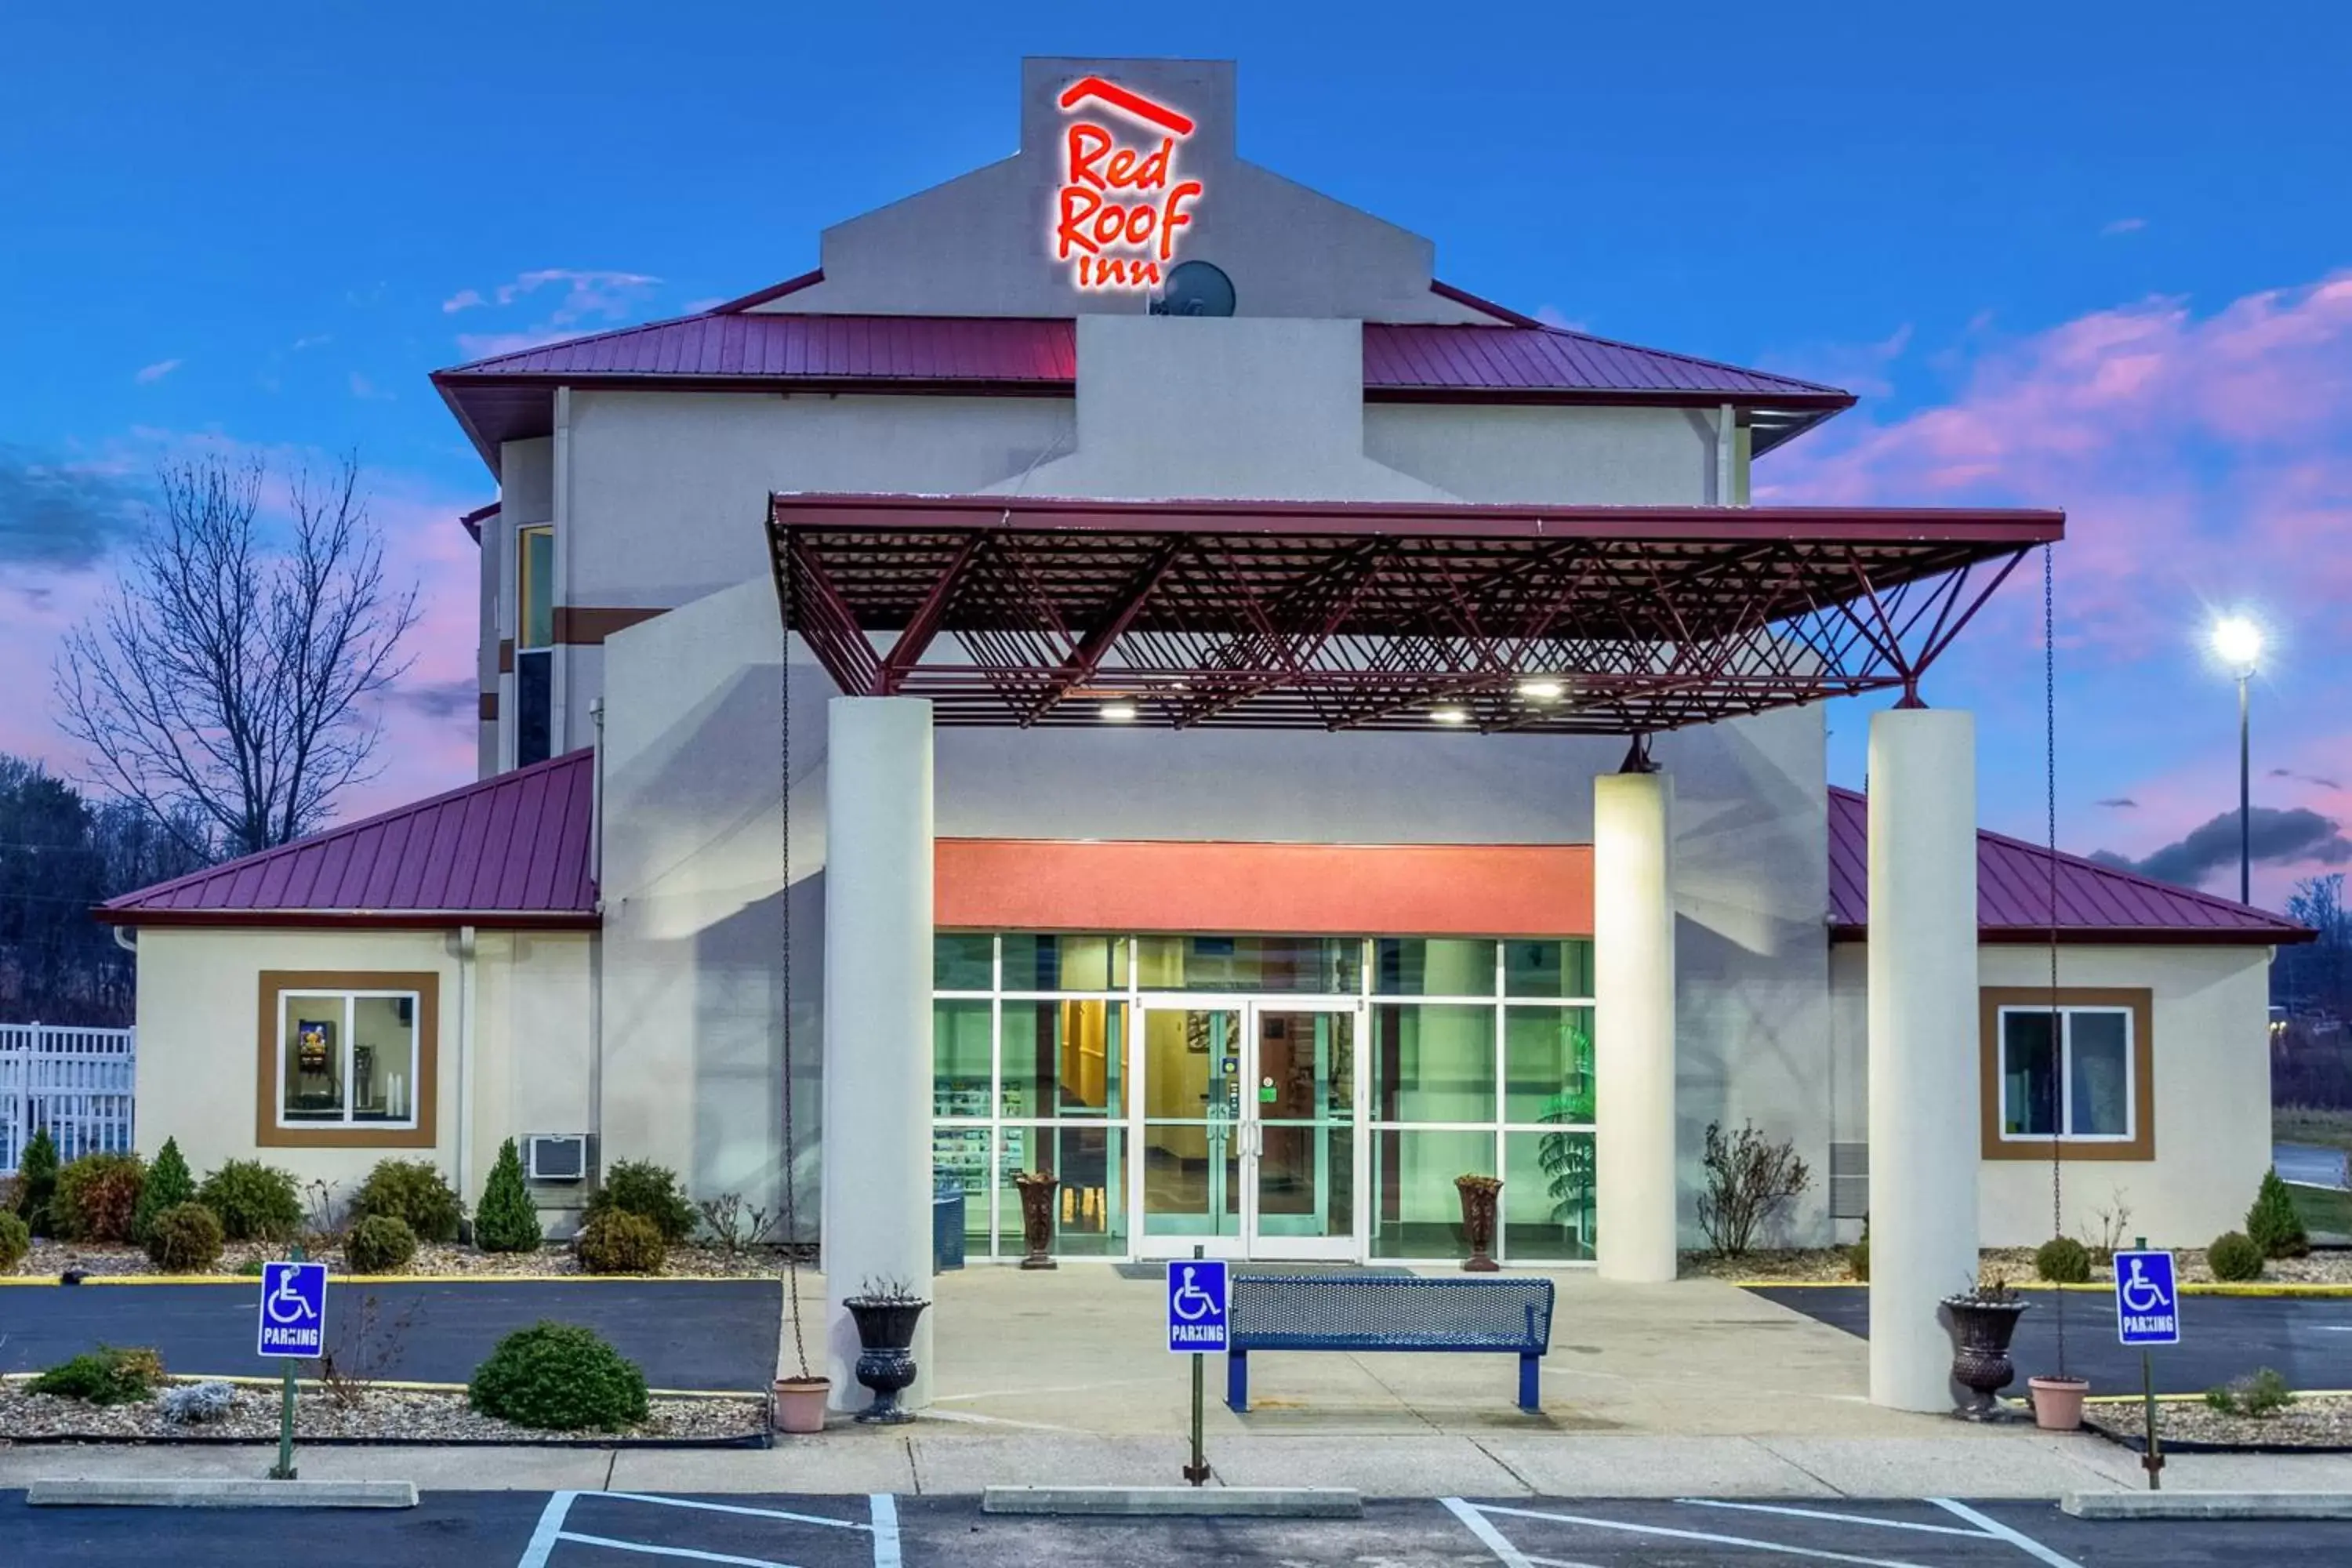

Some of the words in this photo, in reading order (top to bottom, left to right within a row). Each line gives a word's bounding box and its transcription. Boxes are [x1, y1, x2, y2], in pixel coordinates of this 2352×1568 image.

[1069, 124, 1173, 191] Red
[1058, 181, 1203, 260] Roof
[1172, 1325, 1224, 1341] PARKING
[2123, 1316, 2174, 1333] PARKING
[263, 1327, 318, 1346] PARKING
